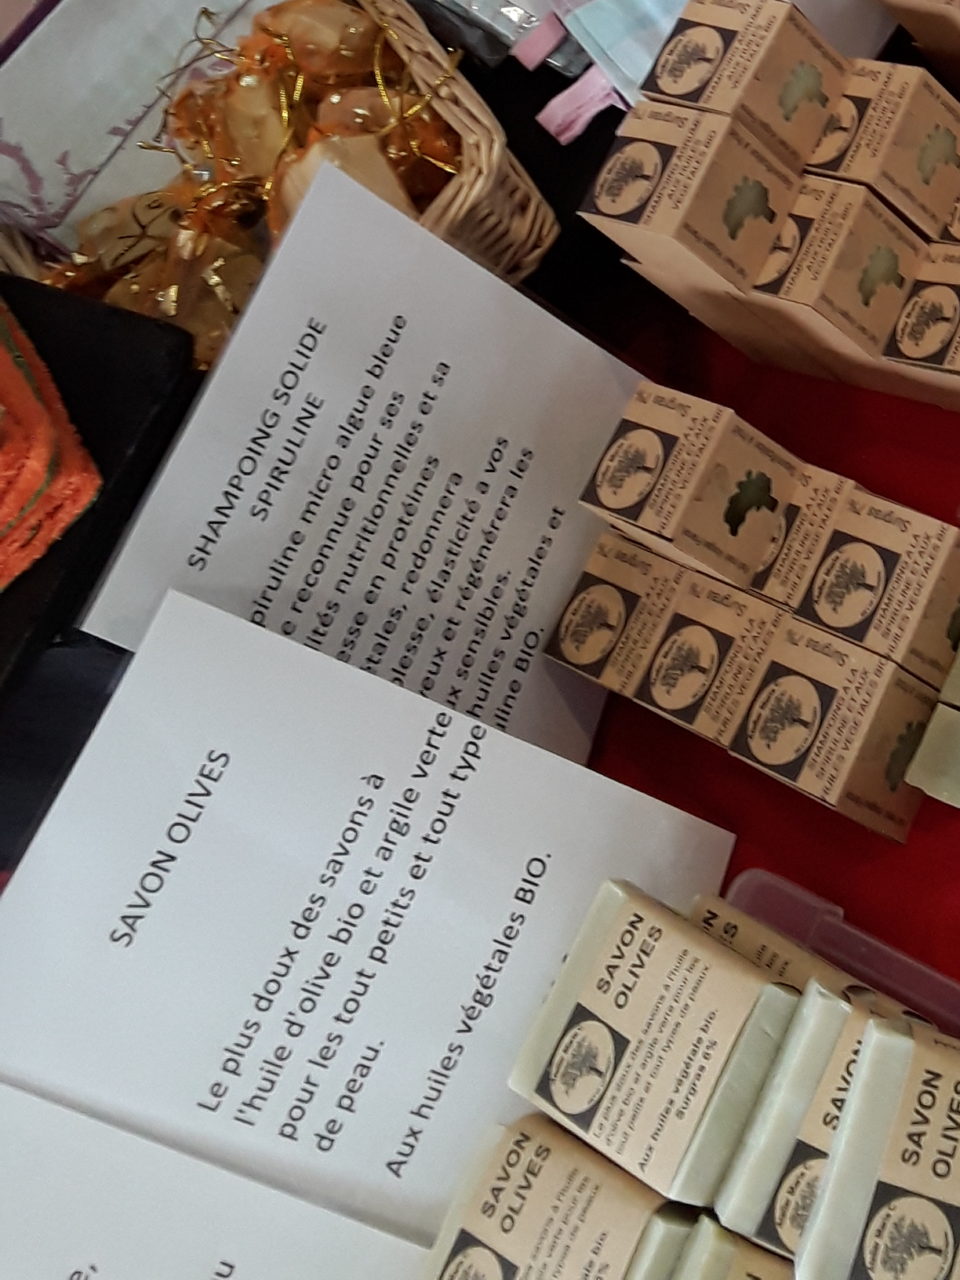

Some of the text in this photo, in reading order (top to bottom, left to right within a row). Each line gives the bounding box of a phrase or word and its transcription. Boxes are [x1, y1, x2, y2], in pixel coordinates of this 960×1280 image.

[188, 321, 326, 571] SHAMPOING SOLIDE
[249, 315, 406, 628] piruline micro algue bleue
[250, 395, 324, 522] SPIRULINE
[290, 393, 405, 614] reconnue pour ses
[335, 362, 451, 595] nutritionnelles et sa
[109, 749, 230, 947] SAVON OLIVES
[196, 774, 385, 1112] Le plus doux des savons à
[233, 712, 452, 1126] l'huile d'olive bio et argile verte
[278, 724, 487, 1142] pour les tout petits et tout type
[385, 854, 552, 1179] Aux huiles végétales BIO.
[596, 912, 645, 995] SAVON
[614, 926, 663, 1010] OLIVES
[313, 1041, 384, 1152] de peau.
[481, 1131, 532, 1219] SAVON
[822, 1039, 863, 1131] SAVO
[901, 1068, 944, 1168] SAVON
[500, 1144, 552, 1236] OLIVES
